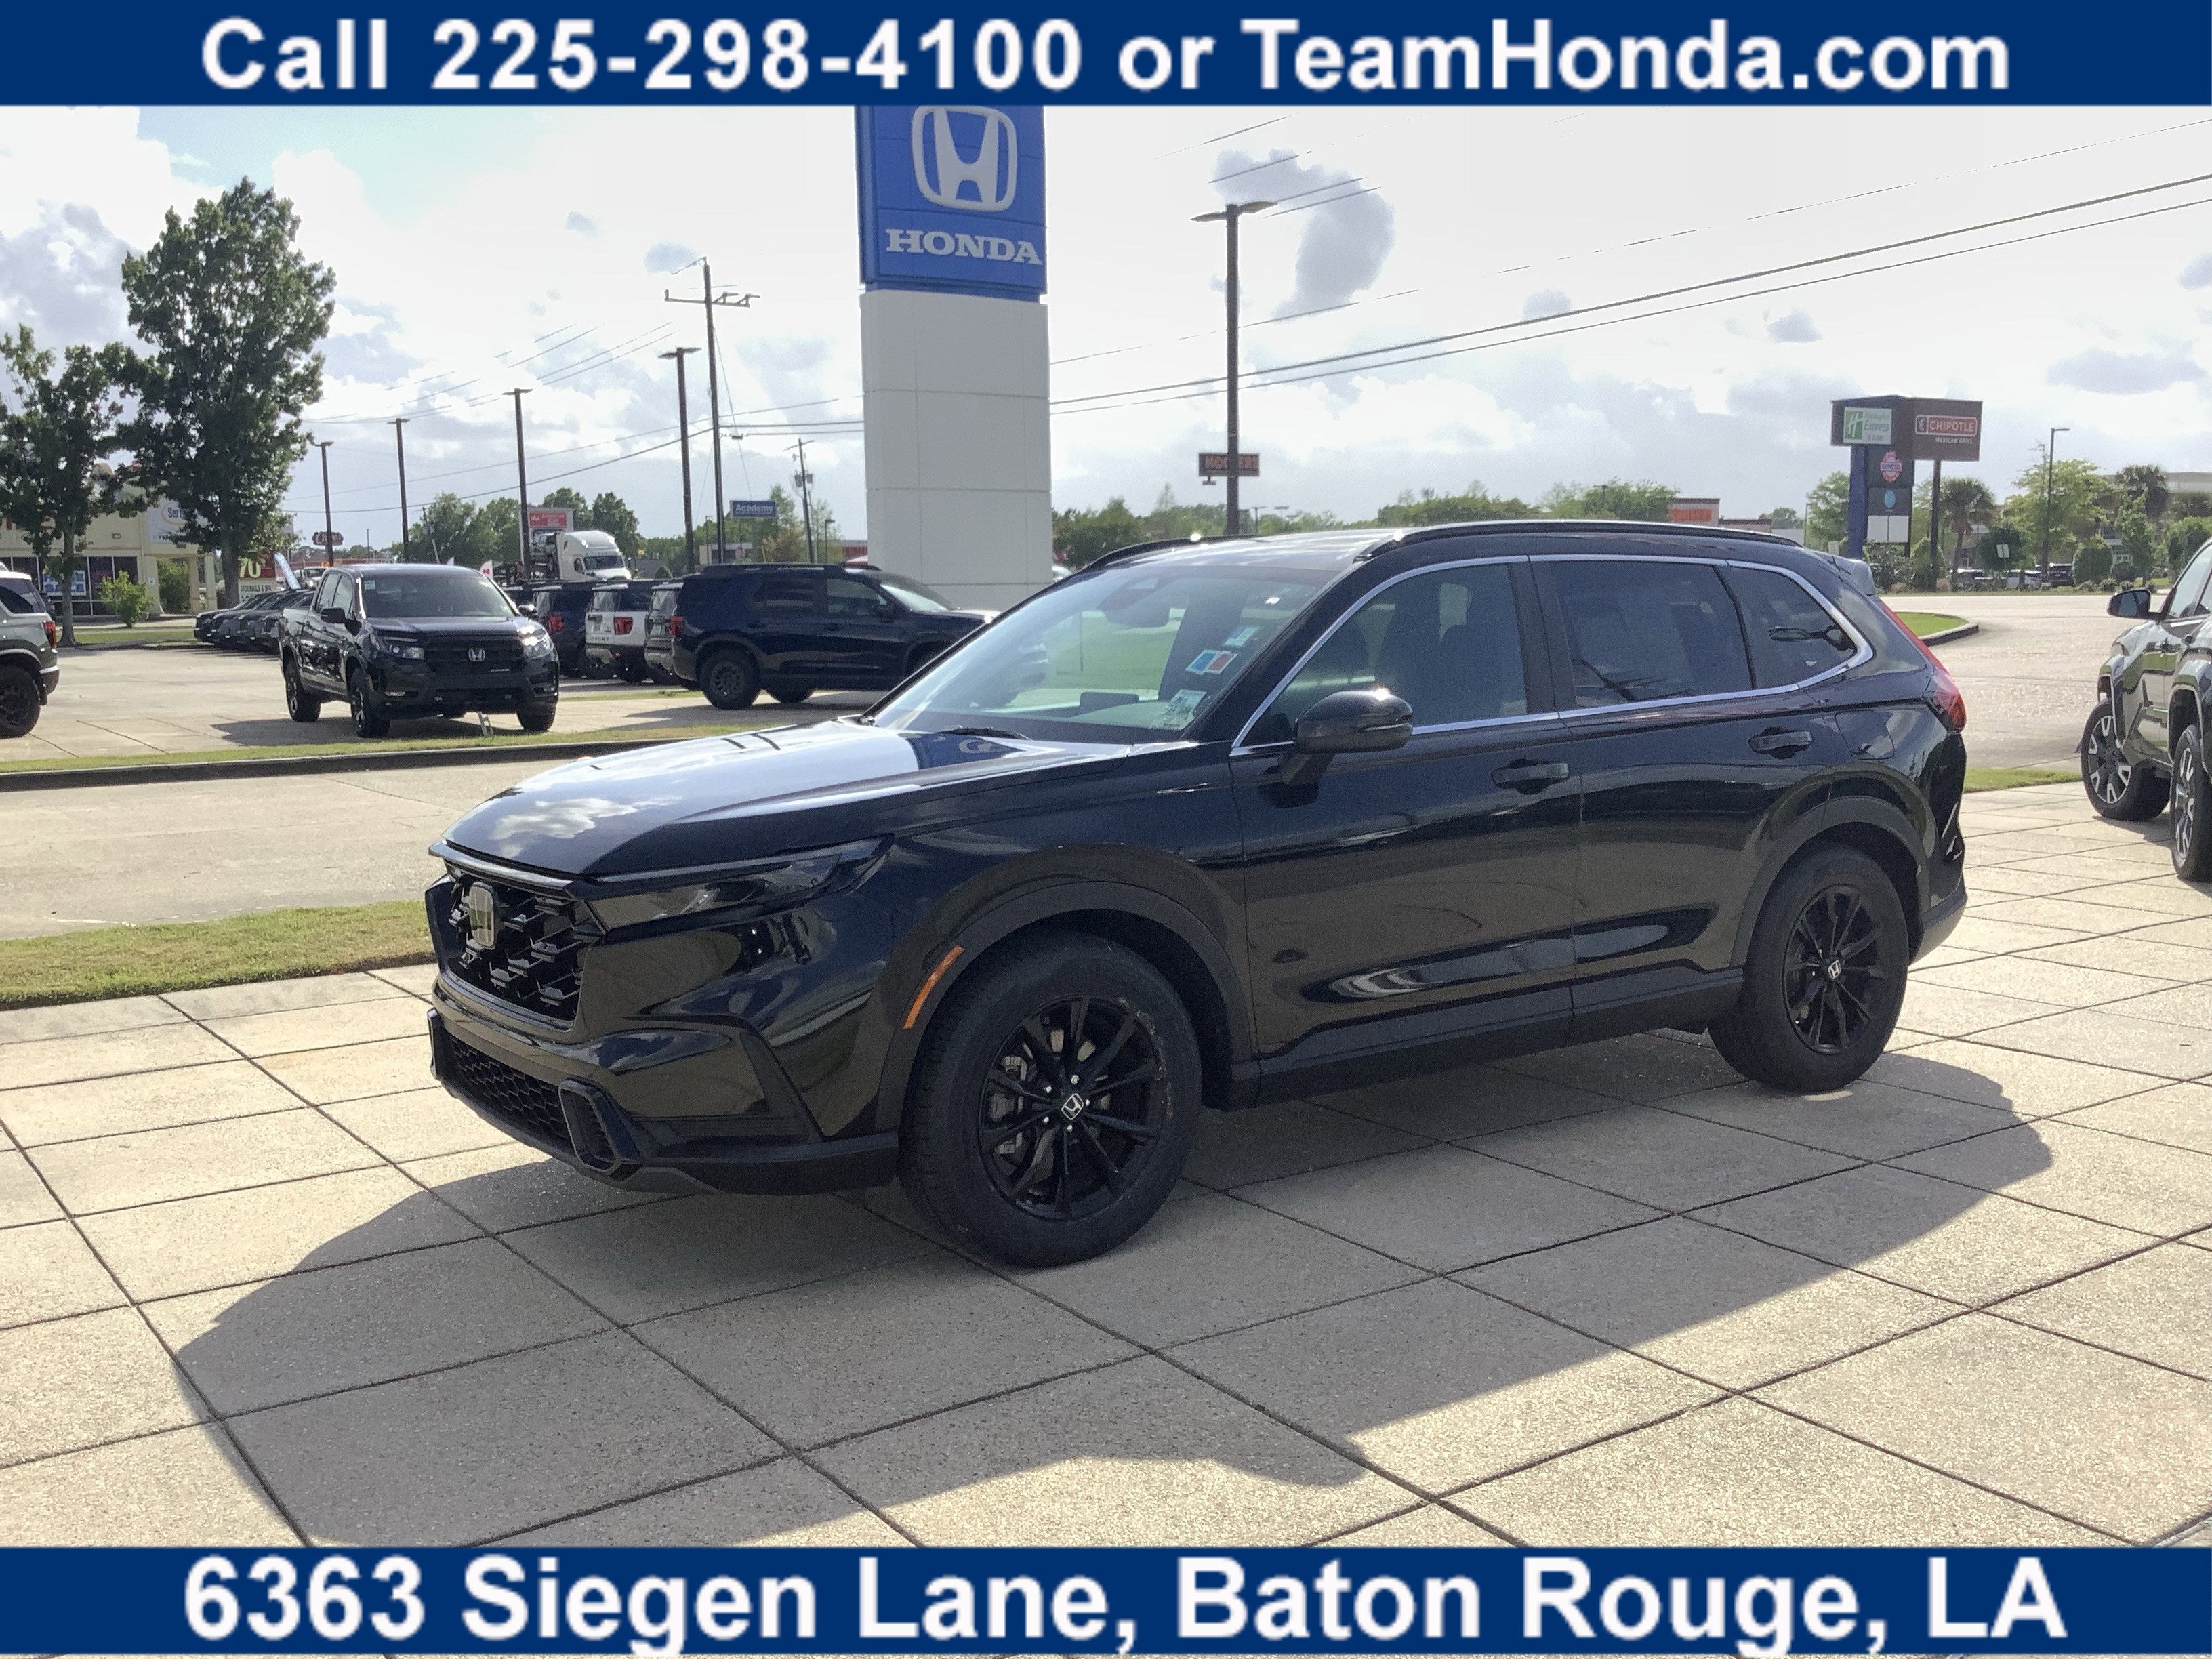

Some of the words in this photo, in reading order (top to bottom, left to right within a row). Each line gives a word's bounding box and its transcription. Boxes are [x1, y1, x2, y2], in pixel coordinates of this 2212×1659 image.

[885, 228, 1043, 265] HONDA
[1864, 419, 1889, 432] Express
[1929, 420, 1974, 432] CHIPOTLE
[735, 504, 773, 514] Academy
